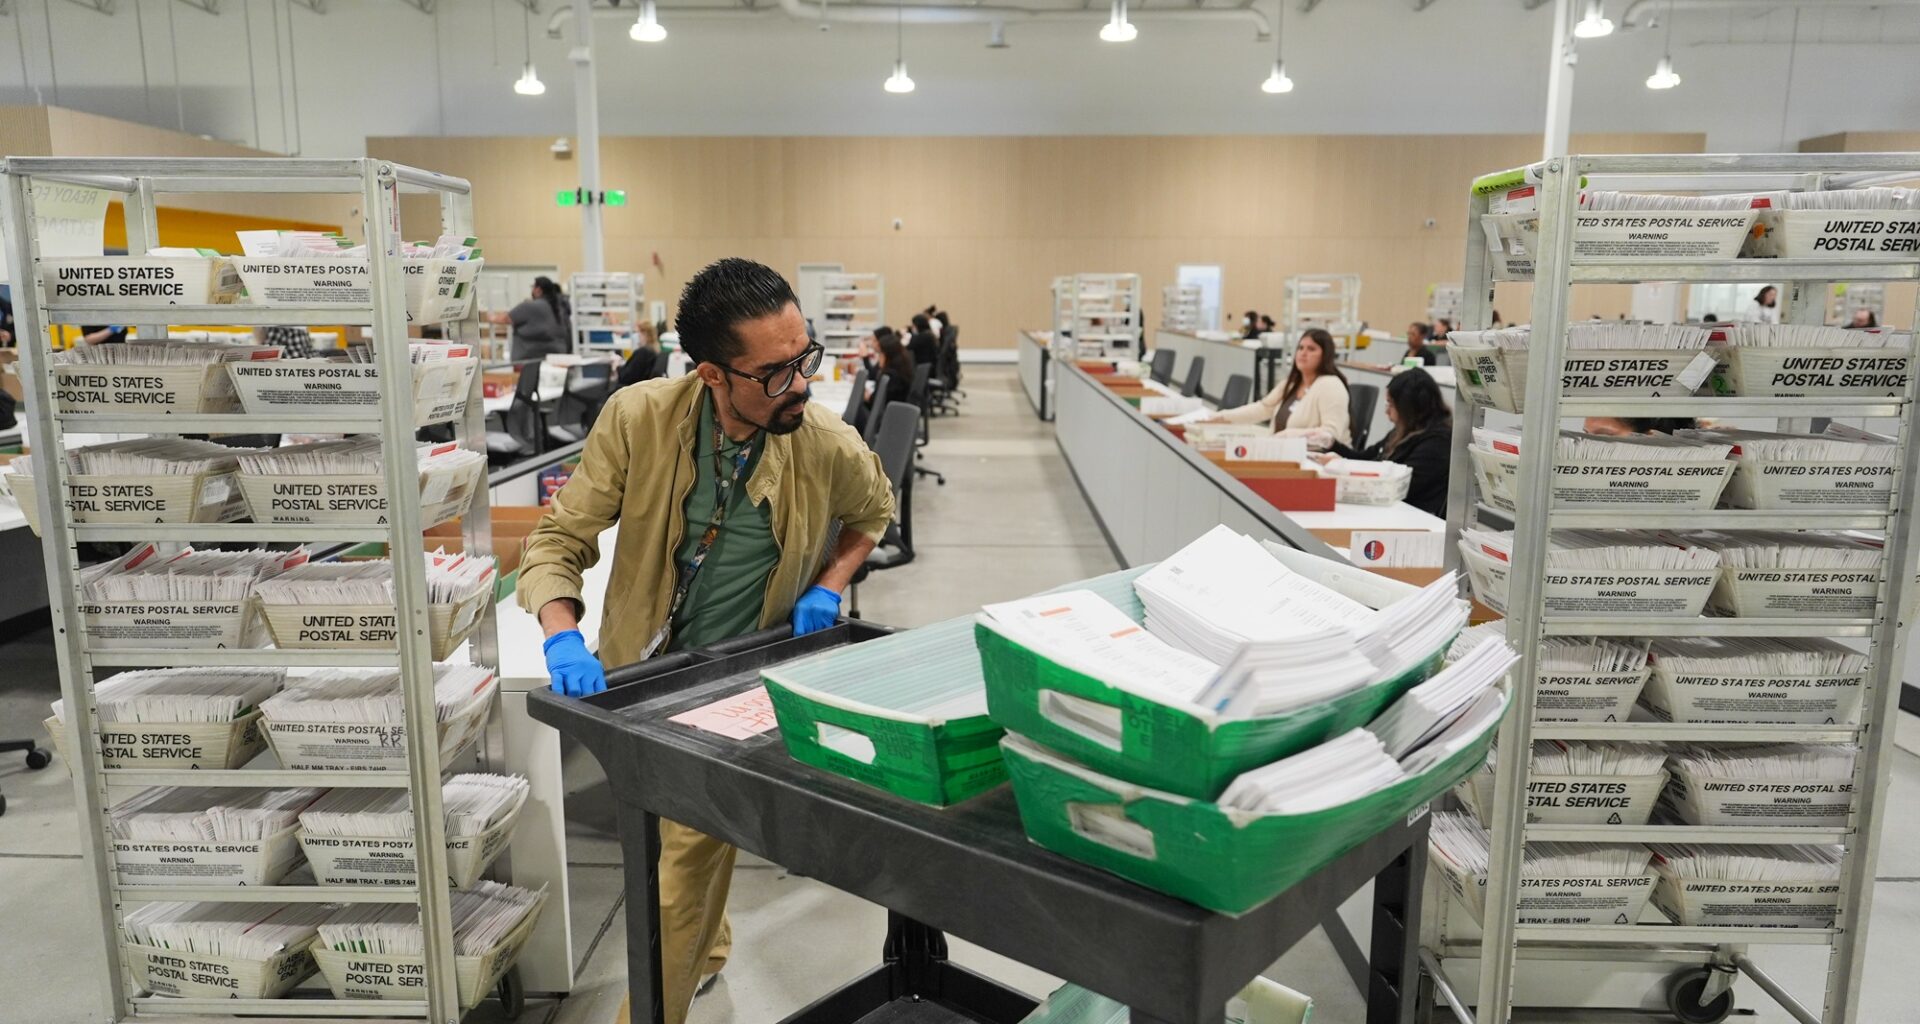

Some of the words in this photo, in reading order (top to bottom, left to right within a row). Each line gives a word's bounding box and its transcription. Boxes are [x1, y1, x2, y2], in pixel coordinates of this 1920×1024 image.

[1576, 218, 1599, 227] TED
[1602, 218, 1646, 227] STATES
[1649, 218, 1694, 228] POSTAL
[1696, 218, 1746, 227] SERVICE
[1824, 221, 1884, 234] UNITED
[1886, 221, 1920, 234] STAT
[1813, 238, 1875, 250] POSTAL
[1880, 239, 1920, 251] SERV
[59, 267, 114, 279] UNITED
[118, 267, 174, 279] STATES
[243, 265, 281, 274] UNITED
[283, 265, 326, 275] STATES
[328, 265, 368, 275] POSTA
[56, 284, 115, 296] POSTAL
[118, 284, 183, 296] SERVICE
[1565, 360, 1606, 371] ITED
[1608, 360, 1669, 371] STATES
[1782, 358, 1843, 370] UNITED
[1846, 358, 1907, 370] STATES
[237, 367, 273, 377] UNITED
[275, 368, 316, 378] STATES
[318, 368, 361, 378] POSTAL
[58, 376, 108, 388] UNITED
[112, 377, 163, 388] STATES
[1563, 375, 1599, 388] STAL
[1603, 375, 1674, 388] SERVICE
[1771, 374, 1835, 386] POSTAL
[1839, 374, 1907, 387] SERVICE
[57, 391, 109, 403] POSTAL
[114, 392, 175, 404] SERVICE
[1556, 466, 1578, 475] TED
[1582, 466, 1626, 476] STATES
[1629, 467, 1674, 476] POSTAL
[1677, 466, 1724, 476] SERVICE
[1763, 466, 1806, 475] UNITED
[1808, 467, 1852, 475] STATES
[1854, 467, 1892, 475] POSTA
[69, 485, 98, 497] TED
[102, 485, 153, 497] STATES
[273, 484, 322, 496] UNITED
[327, 484, 378, 496] STATES
[68, 500, 100, 512] STAL
[104, 500, 166, 511] SERVICE
[272, 499, 324, 511] POSTAL
[329, 498, 387, 511] SERVICE
[1546, 576, 1568, 585] TED
[1571, 576, 1615, 586] STATES
[1616, 576, 1661, 586] POSTAL
[1663, 576, 1712, 586] SERVICE
[1738, 573, 1781, 582] UNITED
[1783, 574, 1828, 583] STATES
[1830, 574, 1876, 583] POSTAL
[104, 606, 145, 614] STATES
[147, 606, 189, 614] POSTAL
[193, 605, 239, 614] SERVICE
[302, 616, 354, 627] UNITED
[359, 616, 395, 627] STAT
[299, 630, 354, 641] POSTAL
[359, 630, 397, 641] SERV
[1550, 677, 1592, 685] POSTAL
[1595, 676, 1641, 685] SERVICE
[1676, 676, 1719, 686] UNITED
[1721, 678, 1765, 687] STATES
[1768, 679, 1811, 688] POSTAL
[1814, 678, 1861, 687] SERVICE
[270, 723, 305, 733] UNITED
[307, 724, 345, 734] STATES
[348, 725, 387, 735] POSTAL
[100, 734, 137, 745] NITED
[141, 734, 191, 744] STATES
[103, 748, 138, 758] STAL
[142, 748, 202, 758] SERVICE
[1529, 782, 1566, 793] ITED
[1569, 783, 1626, 794] STATES
[1704, 783, 1745, 792] UNITED
[1747, 784, 1791, 793] STATES
[1793, 784, 1835, 793] POSTAL
[1528, 796, 1561, 807] STAL
[1565, 797, 1631, 808] SERVICE
[173, 845, 212, 853] POSTAL
[215, 845, 258, 853] SERVICE
[305, 839, 340, 847] UNITED
[342, 839, 380, 848] STATES
[382, 840, 413, 849] POSTA
[446, 841, 469, 849] VICE
[1521, 879, 1561, 888] STATES
[1562, 879, 1604, 888] POSTAL
[1606, 878, 1650, 887] SERVICE
[1686, 884, 1726, 893] UNITED
[1728, 885, 1770, 894] STATES
[1772, 885, 1814, 893] POSTAL
[148, 954, 186, 968] UNITED
[189, 961, 229, 975] STATES
[348, 961, 393, 973] UNITED
[397, 964, 424, 975] STAT
[148, 965, 189, 981] POSTAL
[191, 973, 239, 989] SERVICE
[346, 973, 394, 986] POSTAL
